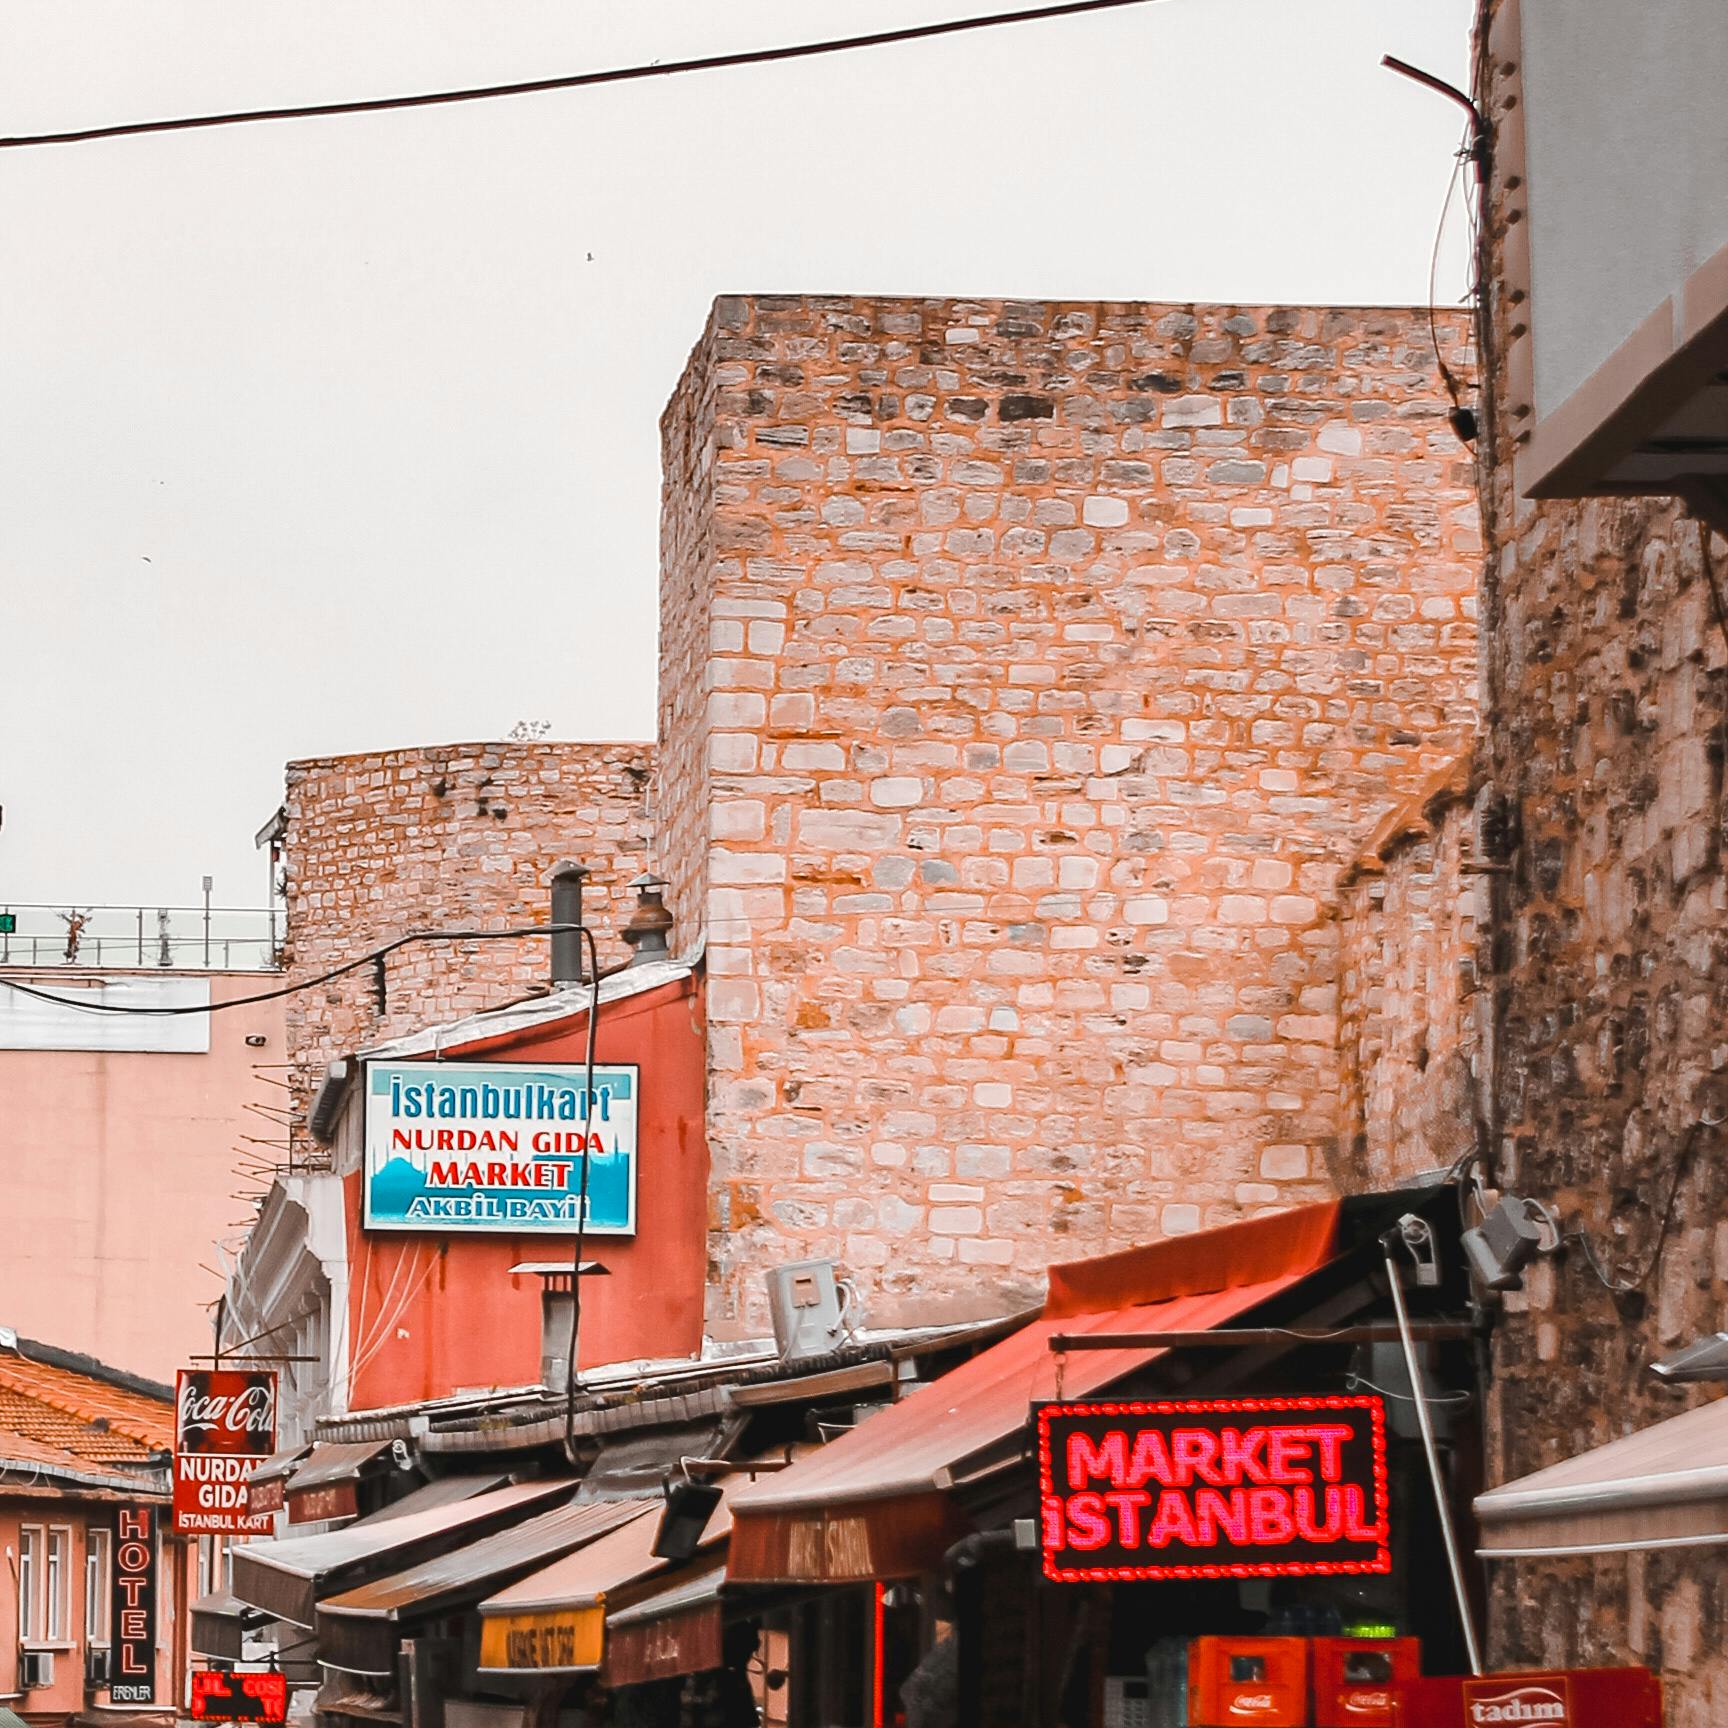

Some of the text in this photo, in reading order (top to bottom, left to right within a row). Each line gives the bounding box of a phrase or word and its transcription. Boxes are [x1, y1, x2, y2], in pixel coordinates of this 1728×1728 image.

[392, 1129, 604, 1153] NURDAN GIDA
[429, 1161, 570, 1187] MARKET
[408, 1193, 501, 1218] AKBİL
[1067, 1424, 1354, 1489] MARKET
[198, 1484, 249, 1509] GIDA
[178, 1511, 268, 1529] İSTANBUL KART
[1042, 1484, 1381, 1551] İSTANBUL
[118, 1510, 150, 1674] HOTEL
